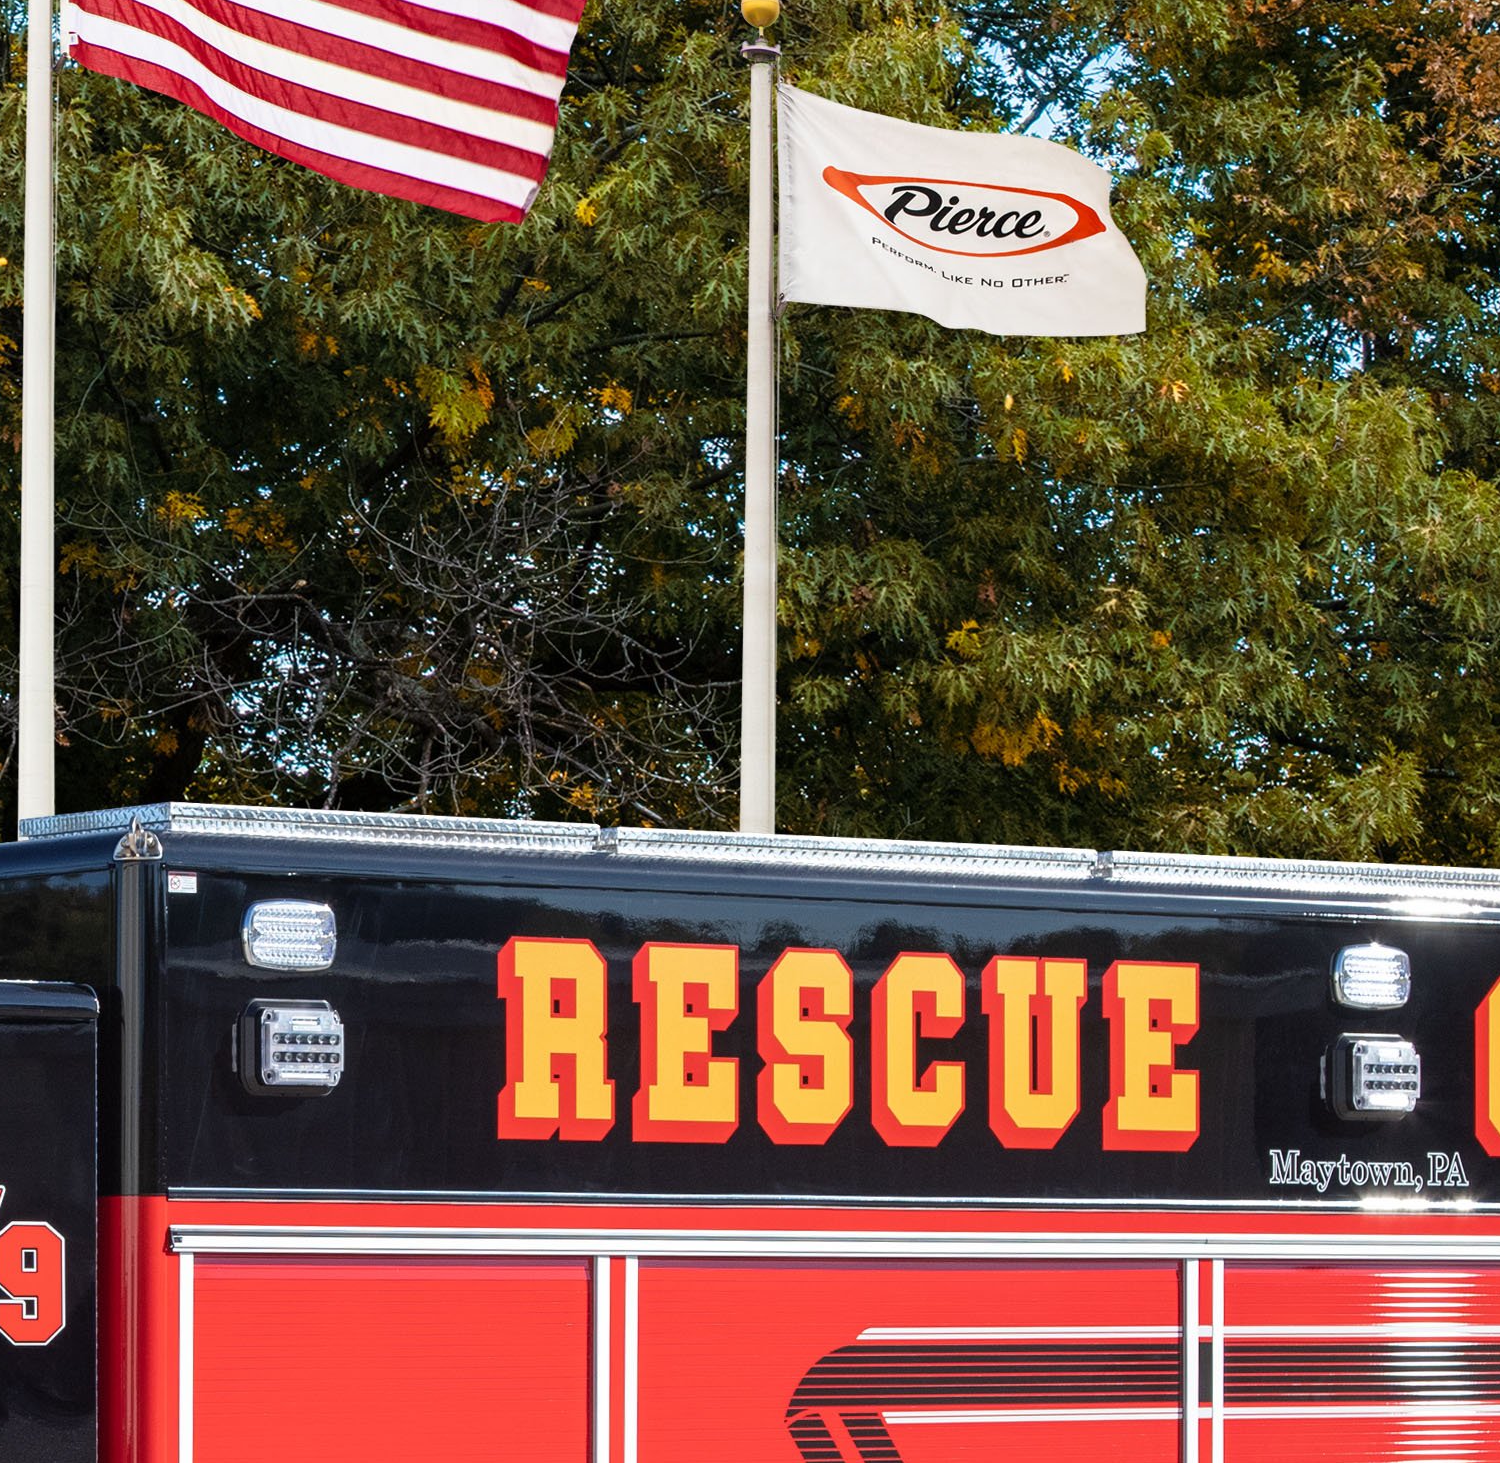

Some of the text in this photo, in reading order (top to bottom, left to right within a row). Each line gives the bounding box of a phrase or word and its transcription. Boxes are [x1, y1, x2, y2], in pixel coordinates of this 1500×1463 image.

[884, 186, 1045, 239] Pierce
[497, 935, 1200, 1152] RESCUE
[1427, 1151, 1470, 1186] PA
